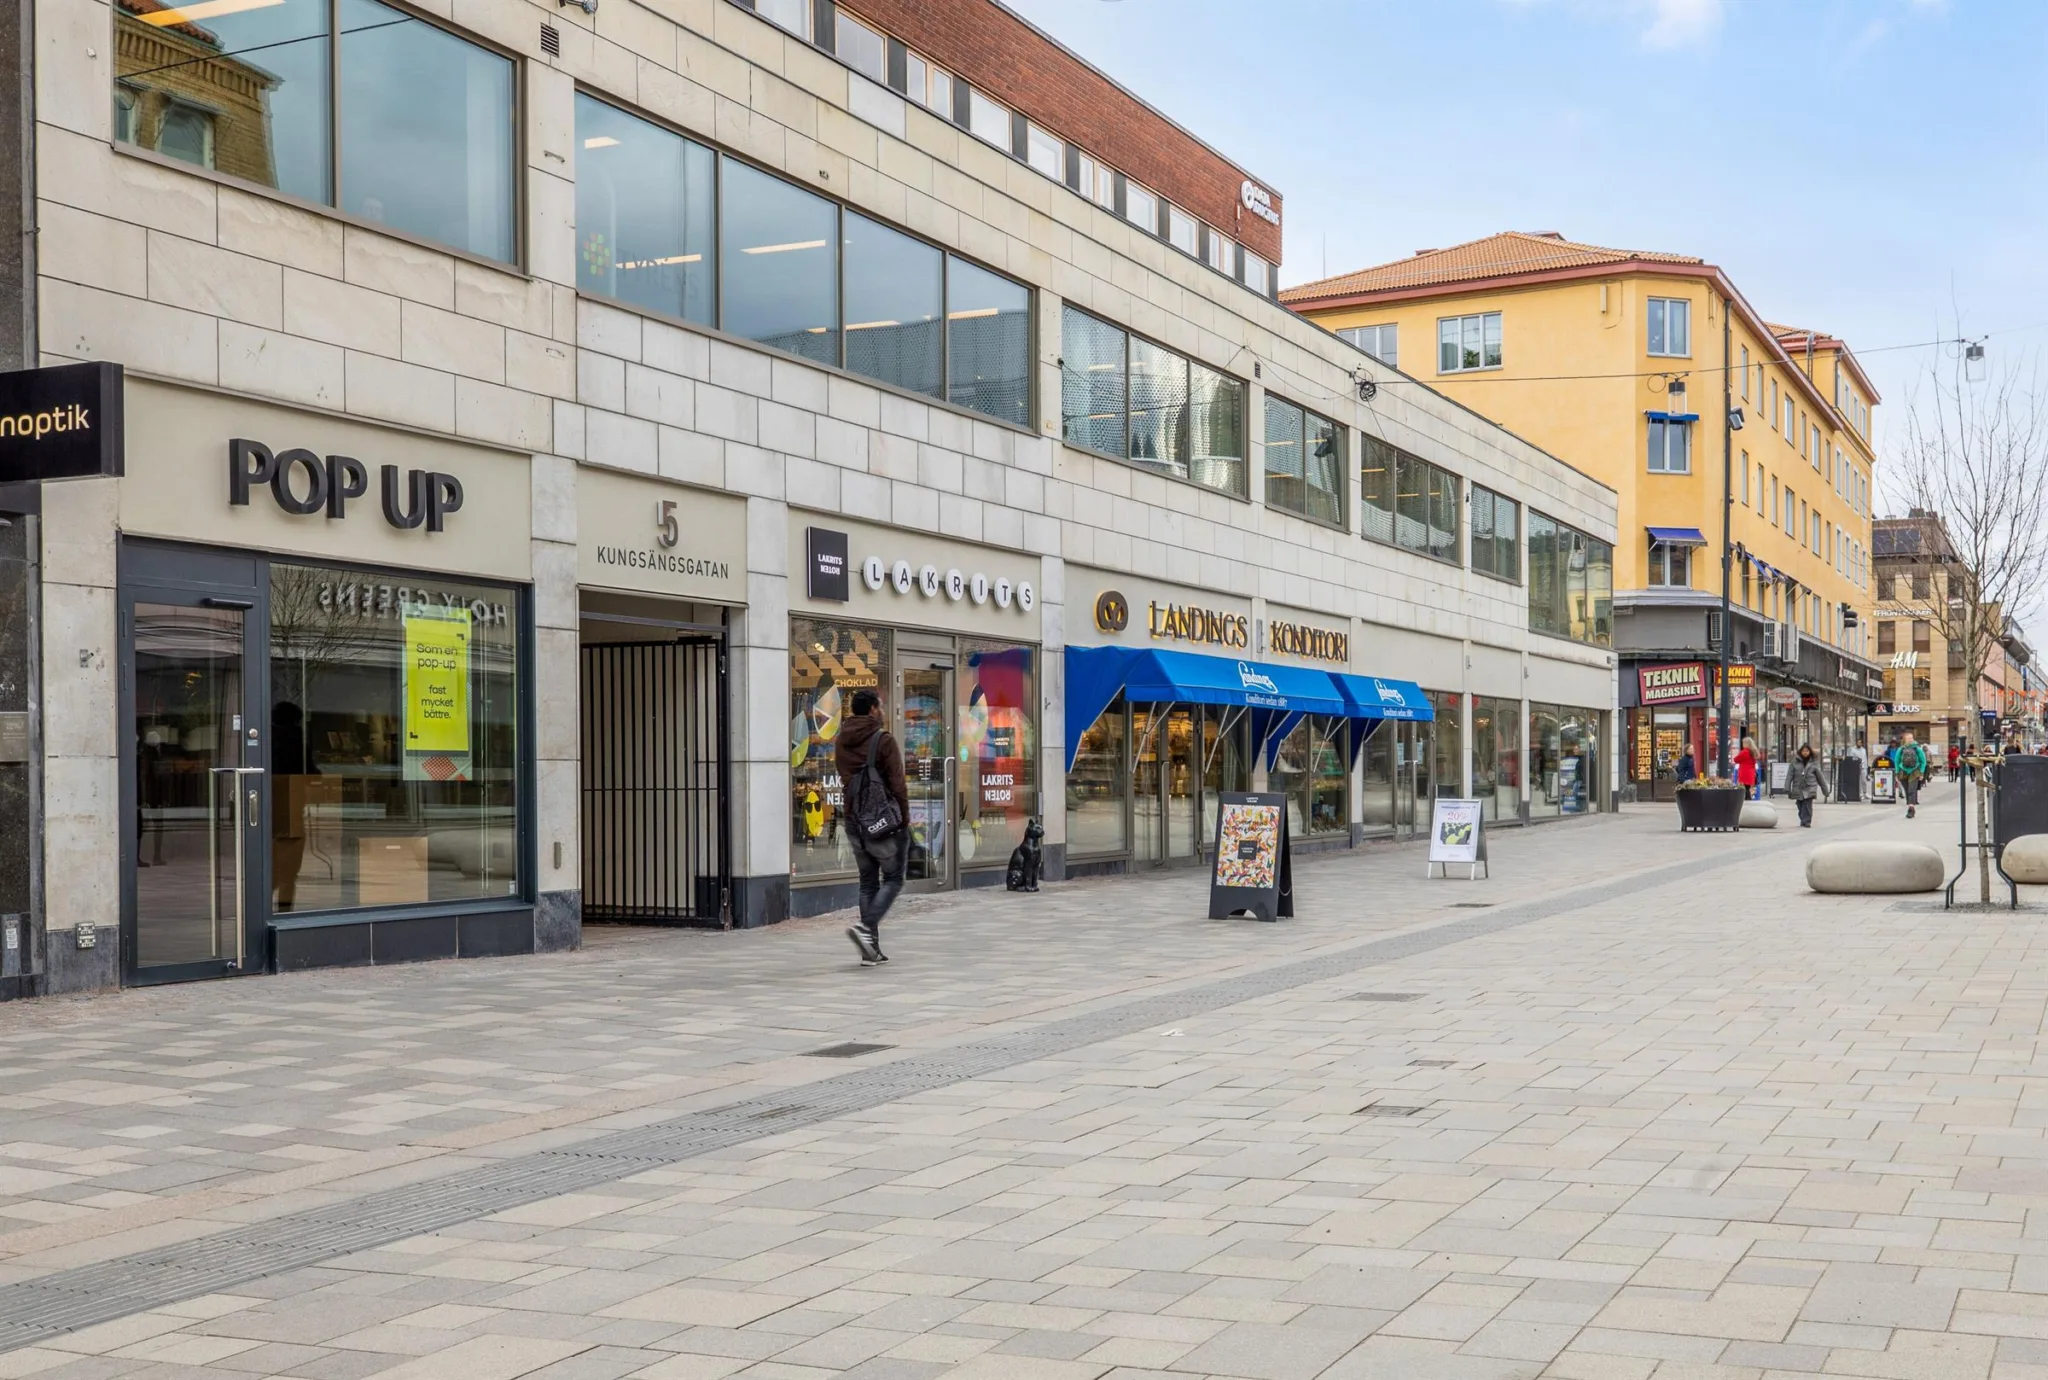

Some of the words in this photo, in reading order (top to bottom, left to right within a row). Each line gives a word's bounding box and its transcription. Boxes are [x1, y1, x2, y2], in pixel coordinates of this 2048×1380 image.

[0, 404, 90, 440] noptik
[229, 438, 369, 520] POP
[381, 464, 465, 533] UP
[656, 499, 679, 549] 5
[597, 545, 729, 580] KUNGSÄNGSGATAN
[817, 553, 843, 566] LAKRITS
[871, 562, 1033, 606] LAKRITS
[1149, 600, 1249, 649] LANDINGS
[1270, 619, 1349, 663] KONDITORI
[416, 643, 442, 655] Som
[444, 647, 458, 655] en
[417, 656, 457, 670] pop-up
[1890, 651, 1918, 669] H&M
[1643, 666, 1700, 688] TEKNIK
[1717, 667, 1752, 677] TKNIK
[428, 684, 446, 695] fast
[834, 678, 878, 688] CHOKLAD
[1645, 684, 1702, 701] MAGASINET
[421, 697, 454, 711] mycket
[423, 708, 452, 720] bättre.
[823, 775, 845, 788] LAK
[981, 774, 1014, 786] LAKRITS
[985, 789, 1011, 801] ROTEN
